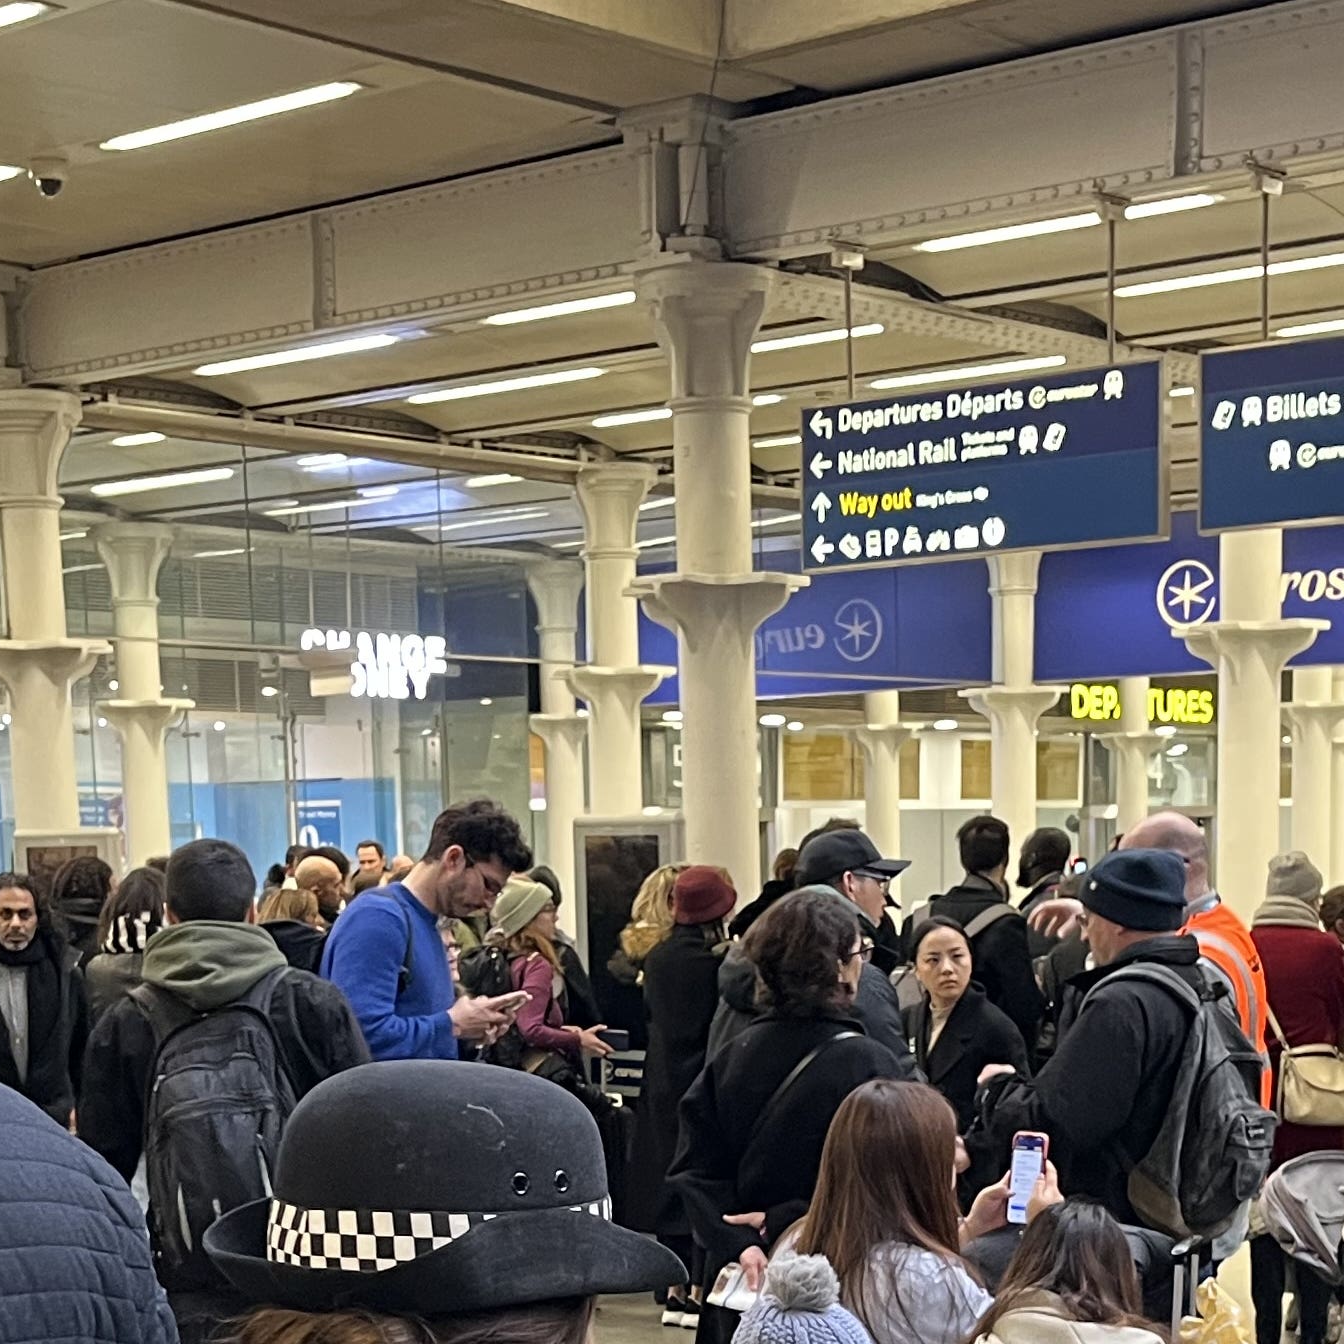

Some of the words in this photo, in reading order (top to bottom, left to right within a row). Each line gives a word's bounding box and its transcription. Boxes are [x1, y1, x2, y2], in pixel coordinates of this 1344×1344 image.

[838, 401, 943, 434] Departures
[947, 387, 1023, 420] Départs
[1266, 389, 1341, 422] Billets
[837, 443, 915, 474] National
[919, 437, 956, 464] Rail
[839, 491, 879, 518] Way
[881, 487, 912, 511] out
[351, 660, 430, 700] ONEY
[1070, 683, 1214, 723] DEPTURES
